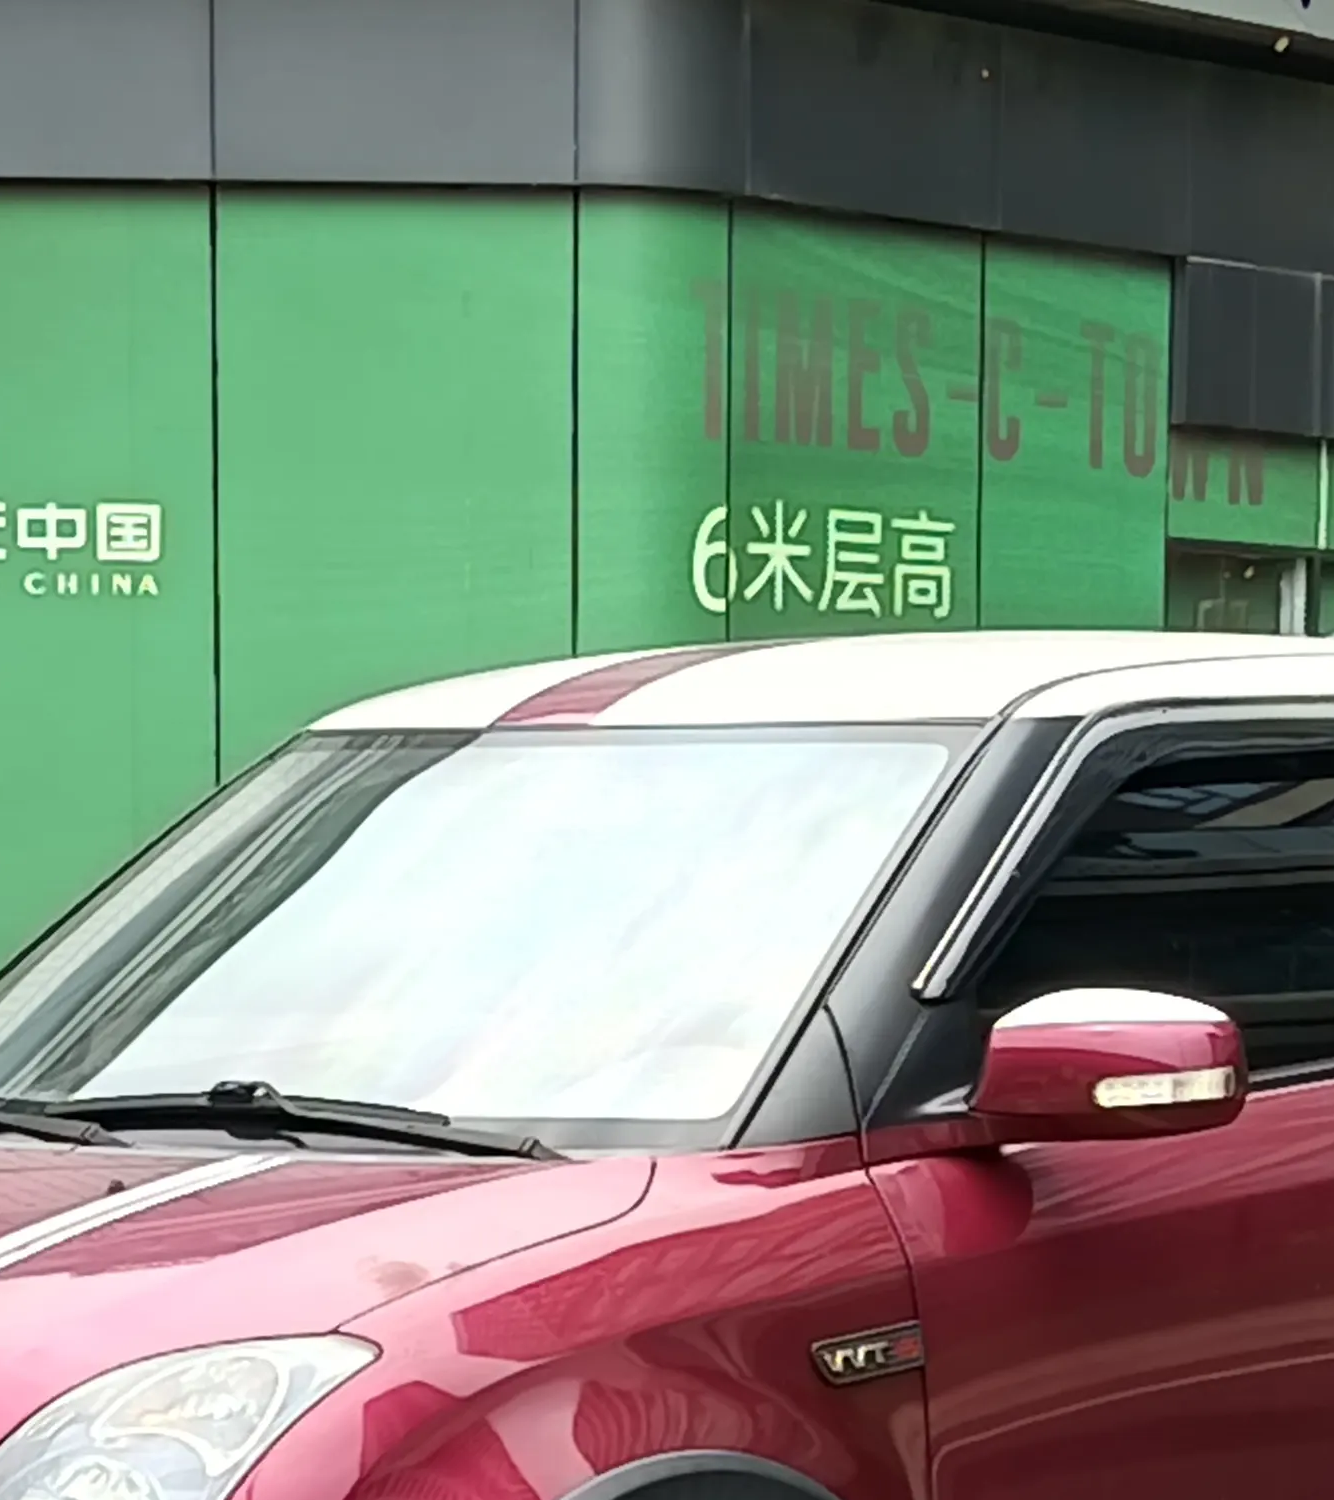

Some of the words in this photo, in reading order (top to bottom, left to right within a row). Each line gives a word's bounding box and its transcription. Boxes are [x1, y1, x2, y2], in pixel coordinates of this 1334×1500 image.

[24, 572, 159, 596] CHINA
[693, 499, 956, 618] 6米层高
